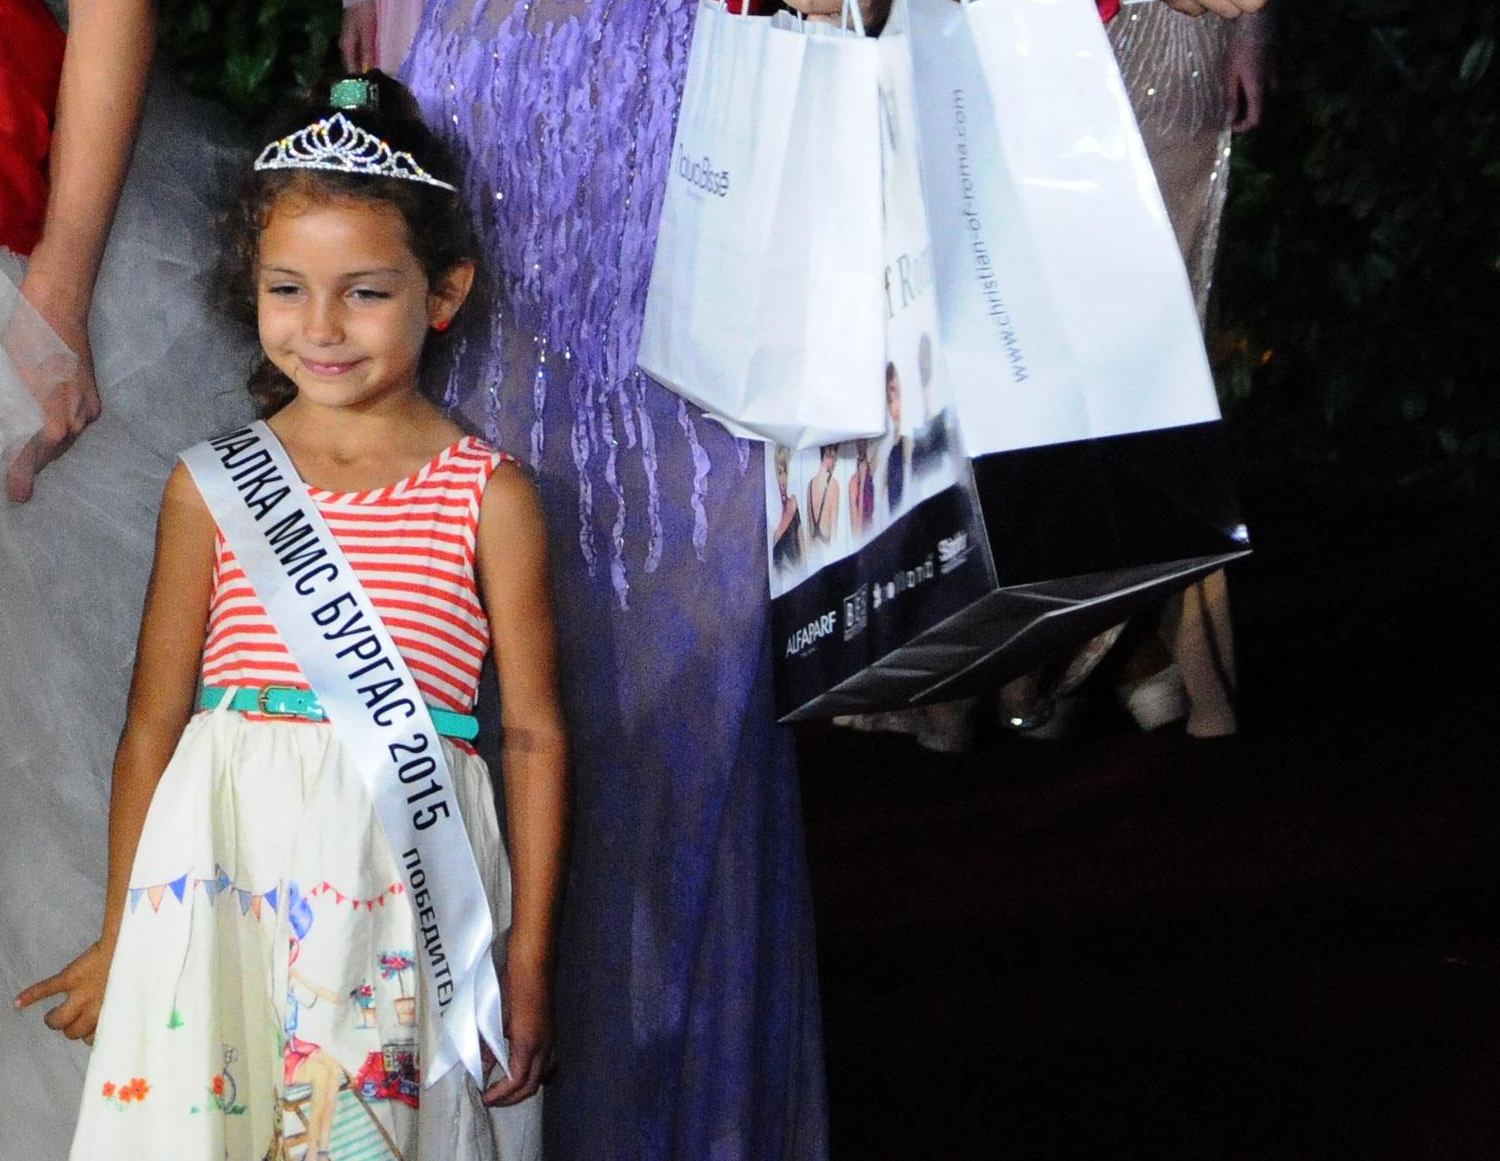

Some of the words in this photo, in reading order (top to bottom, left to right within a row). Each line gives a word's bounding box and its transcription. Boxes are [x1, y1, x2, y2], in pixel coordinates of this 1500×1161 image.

[264, 508, 339, 596] МИС
[311, 590, 416, 727] БУРГАС
[387, 733, 451, 832] 2015
[785, 610, 838, 659] ALFAPARF
